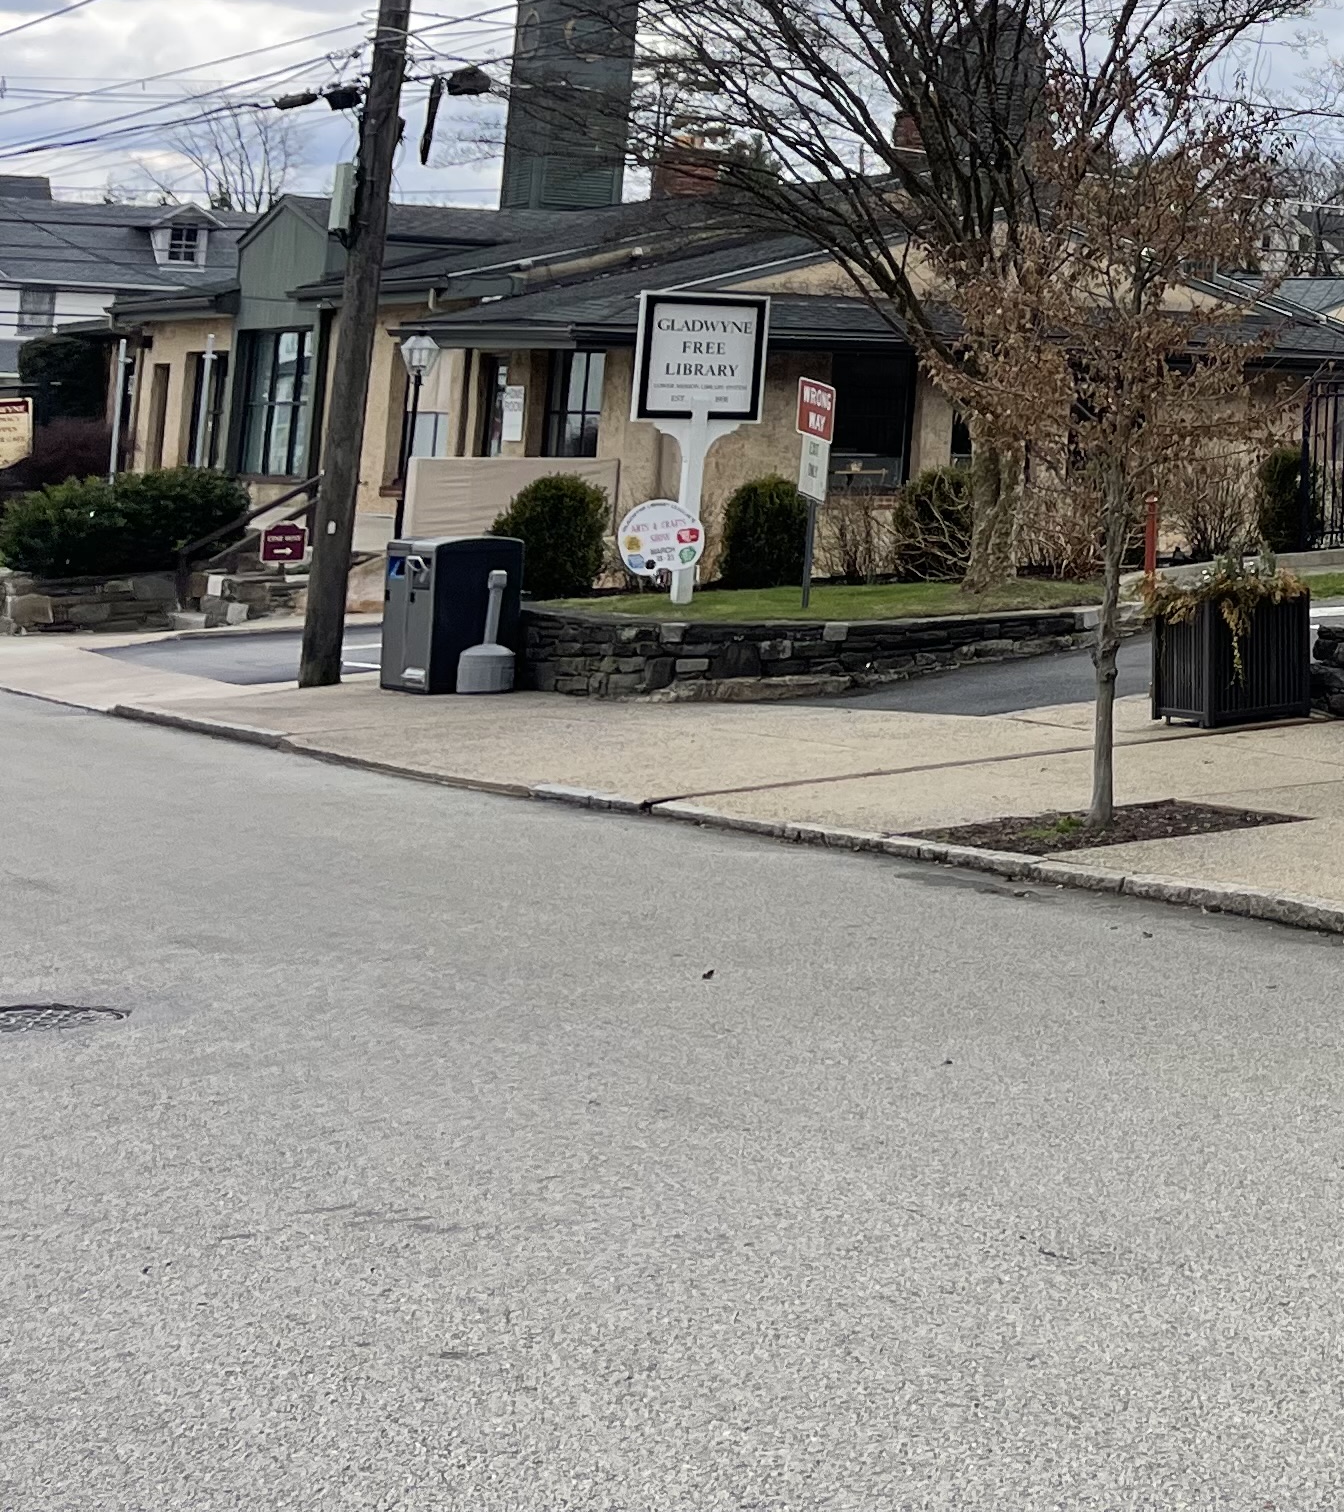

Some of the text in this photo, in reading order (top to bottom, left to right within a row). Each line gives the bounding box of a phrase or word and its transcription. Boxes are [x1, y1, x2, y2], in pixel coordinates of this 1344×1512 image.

[657, 318, 753, 335] GLADWYNE
[682, 341, 727, 355] FREE
[665, 362, 739, 377] LIBRARY
[803, 385, 832, 411] WRONG
[808, 411, 826, 432] WAY
